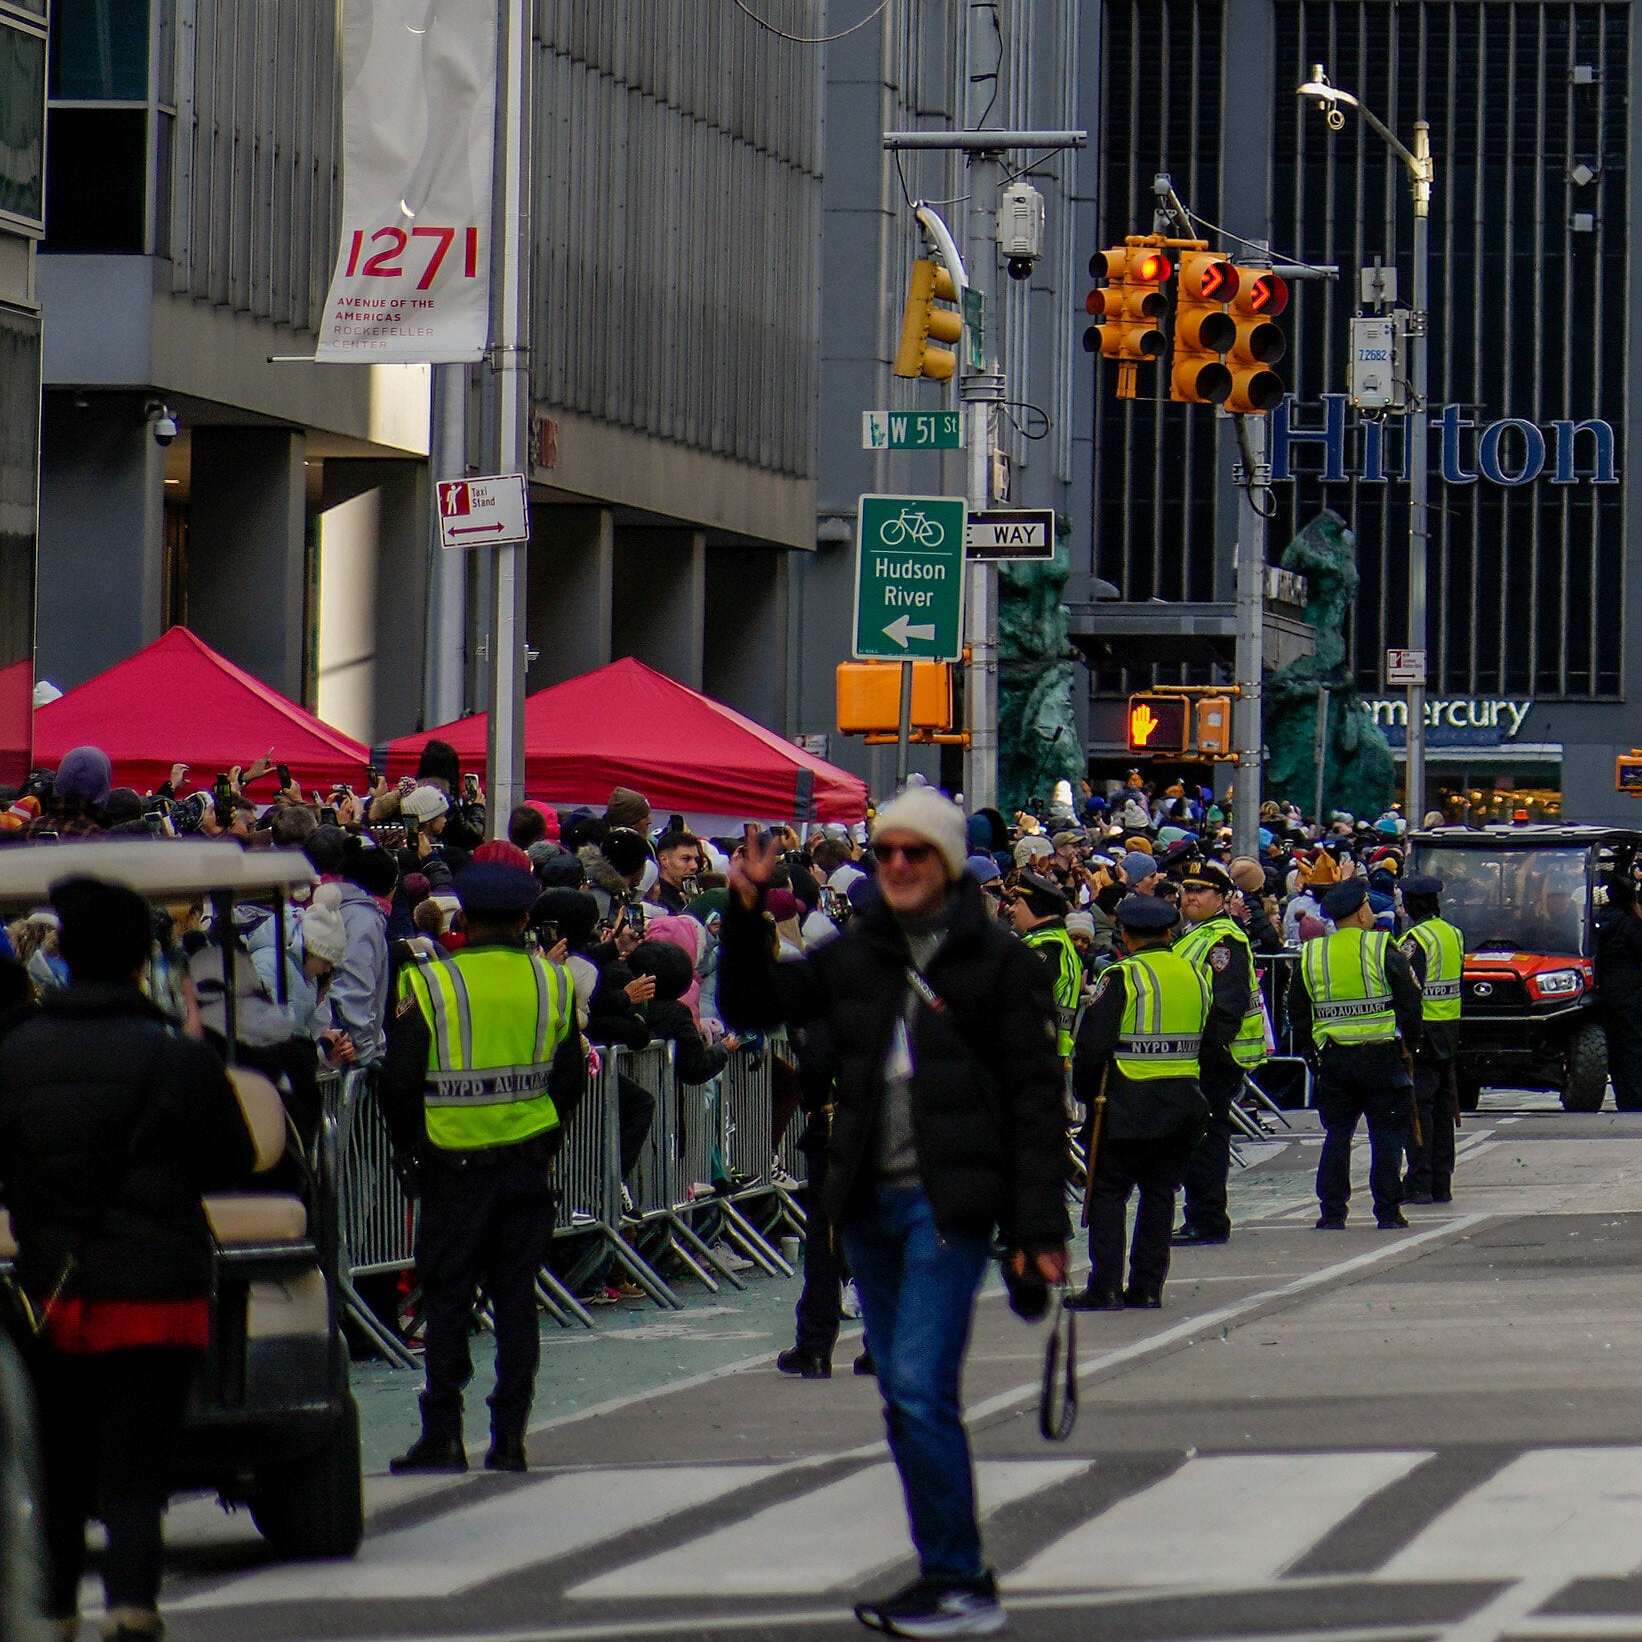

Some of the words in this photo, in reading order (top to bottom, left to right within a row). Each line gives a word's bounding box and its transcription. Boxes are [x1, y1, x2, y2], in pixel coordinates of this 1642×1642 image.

[345, 226, 478, 290] 1271
[337, 298, 386, 308] AVENUE
[390, 299, 404, 308] OF
[411, 300, 435, 308] THE
[335, 312, 401, 322] AMERICAS
[334, 325, 434, 336] ROCKEFELLER
[332, 340, 387, 349] CENTER
[1358, 348, 1388, 361] 72682
[891, 417, 908, 444] W
[916, 417, 936, 444] 51
[944, 416, 957, 434] St
[471, 486, 488, 497] Taxi
[472, 497, 496, 508] Stand
[994, 526, 1037, 544] WAY
[875, 558, 946, 580] Hudson
[884, 586, 934, 607] River
[1422, 986, 1446, 996] NYPD
[1338, 1002, 1386, 1017] AUXILIARY
[1132, 1041, 1170, 1053] NYPD
[438, 1080, 484, 1096] NYPD
